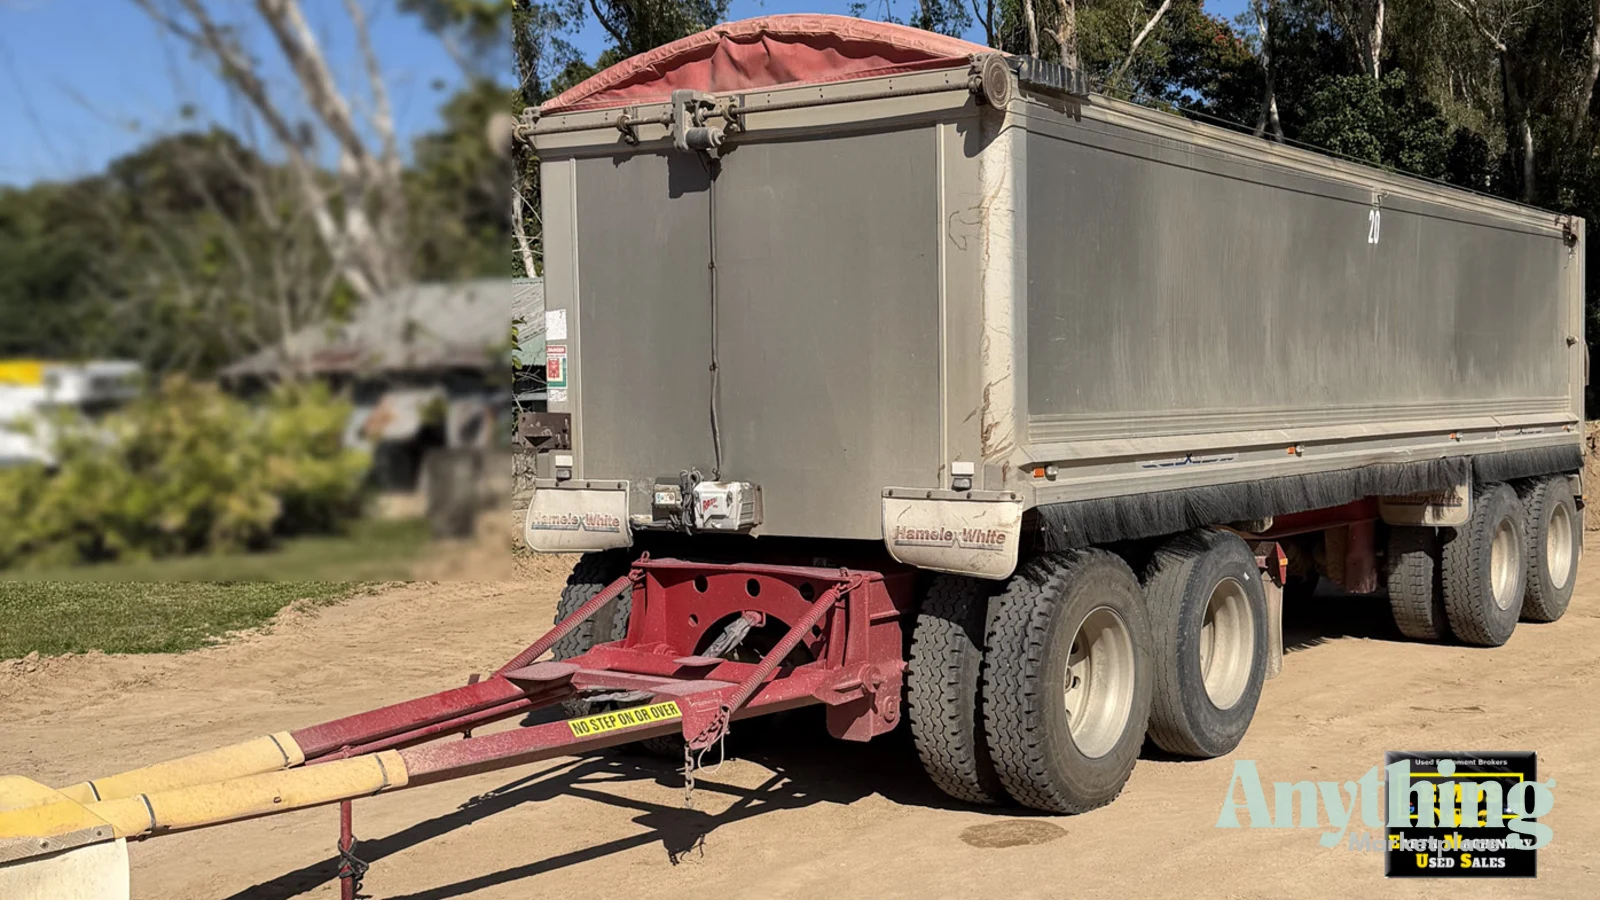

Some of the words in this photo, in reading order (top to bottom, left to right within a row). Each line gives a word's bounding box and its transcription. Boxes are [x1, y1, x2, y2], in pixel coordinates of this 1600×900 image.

[1368, 210, 1380, 244] 20
[586, 513, 620, 526] White
[962, 528, 1006, 545] White
[571, 720, 590, 735] NO
[589, 715, 617, 731] STEP
[618, 709, 635, 725] ON
[635, 706, 652, 721] OR
[649, 703, 679, 718] OVER
